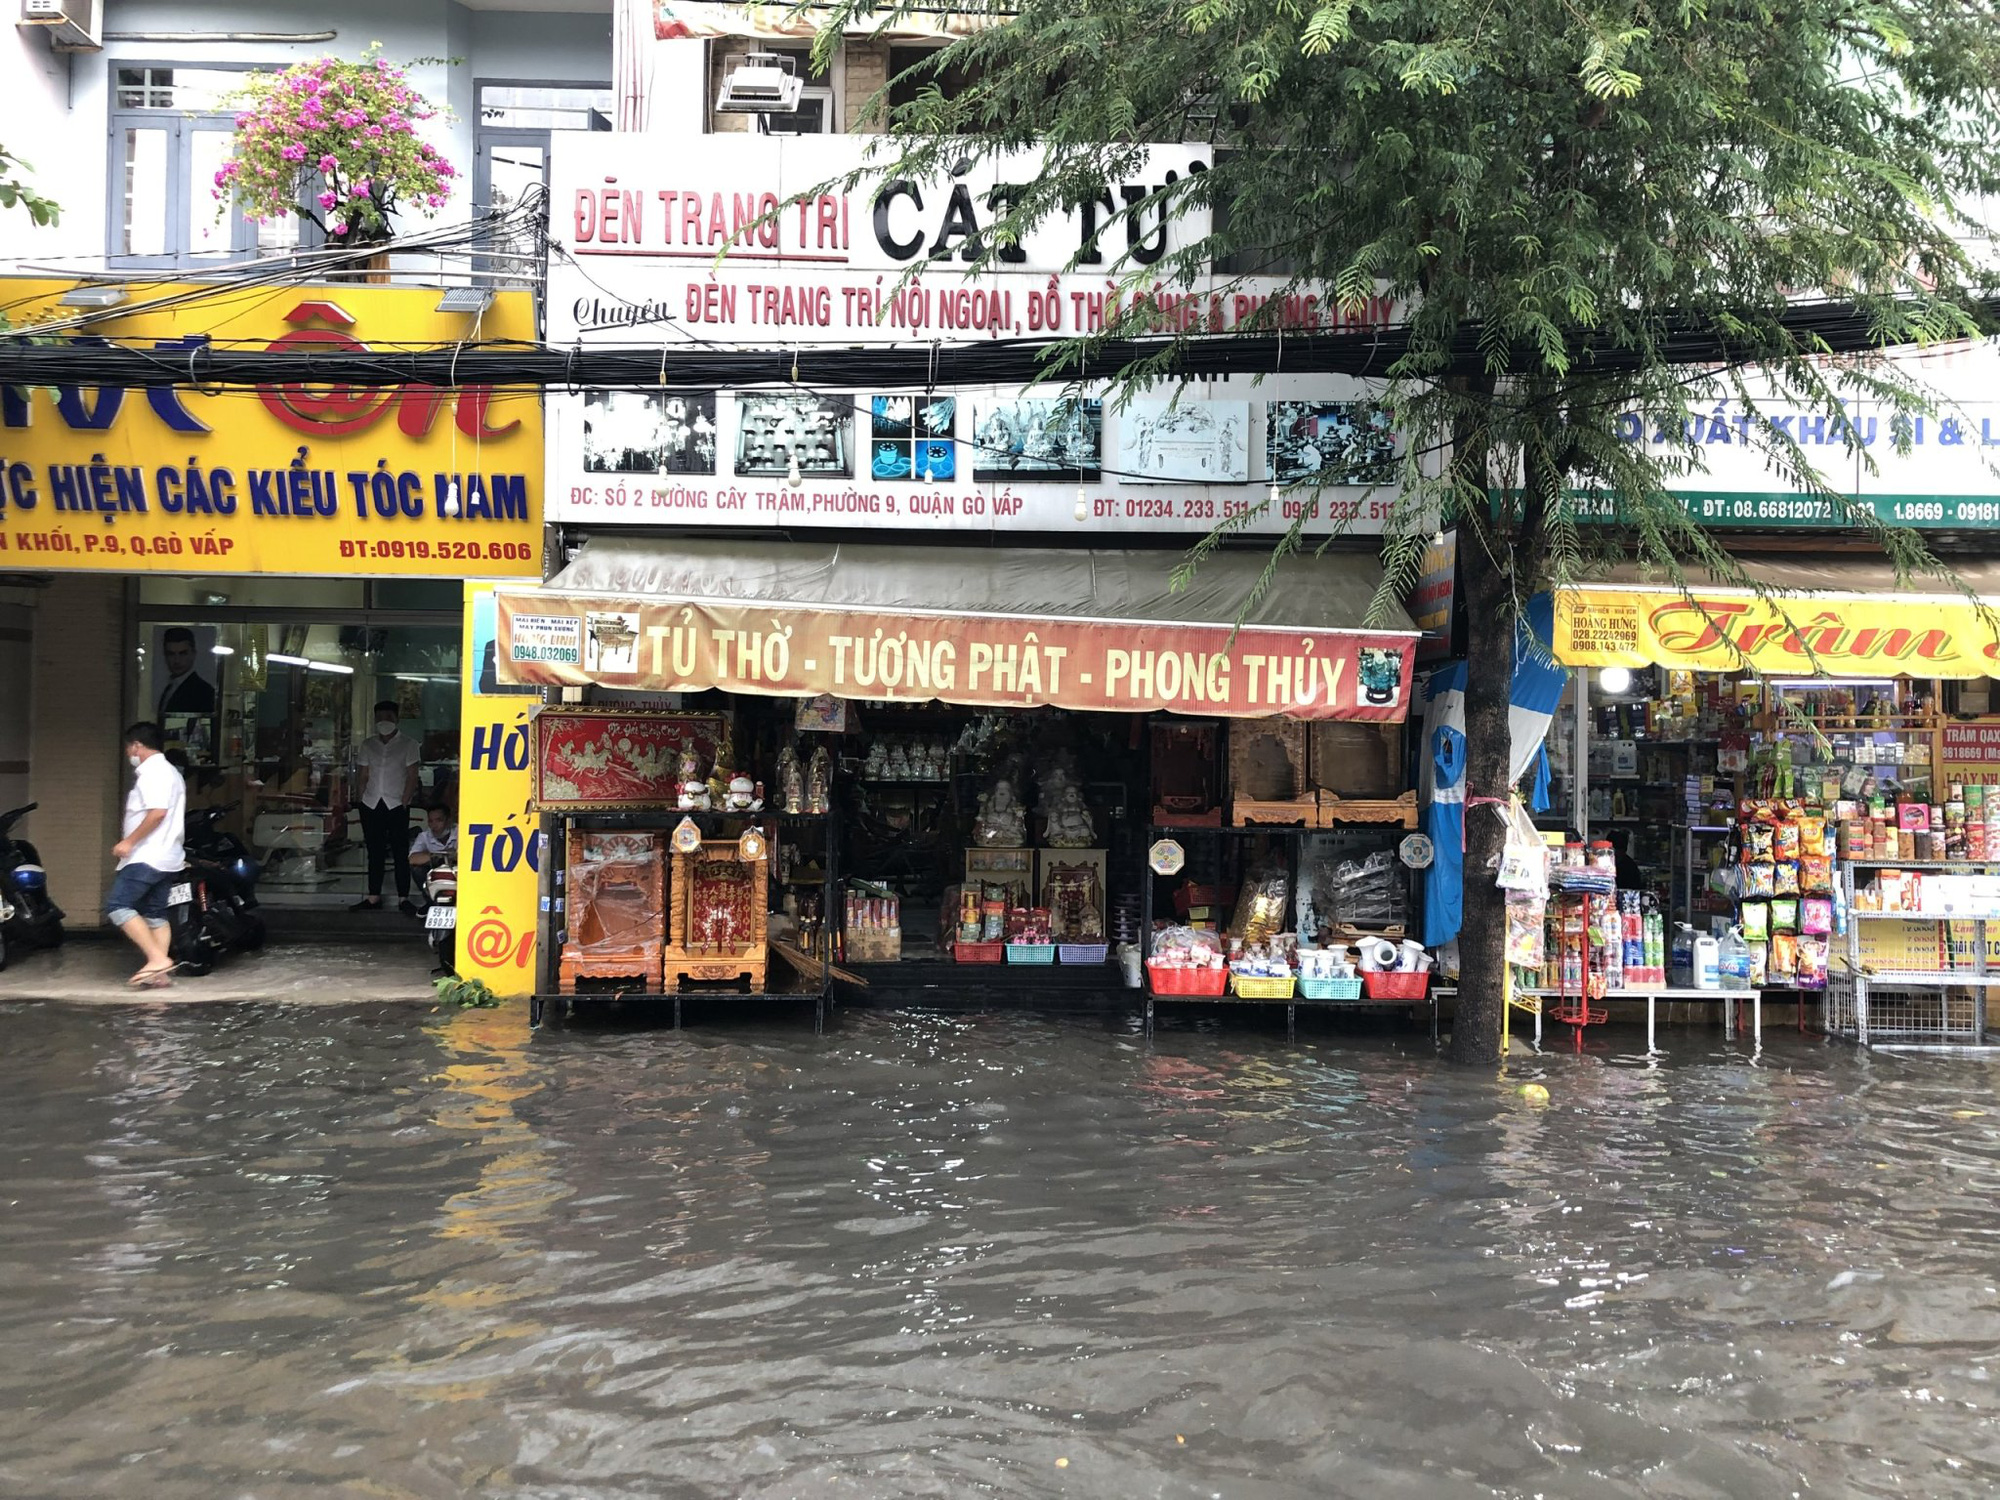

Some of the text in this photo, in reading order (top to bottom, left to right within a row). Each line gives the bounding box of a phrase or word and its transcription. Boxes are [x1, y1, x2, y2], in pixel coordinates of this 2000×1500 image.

[658, 190, 779, 249] TRANG
[573, 297, 673, 327] Chuyên
[686, 272, 736, 324] ĐÈN
[747, 285, 830, 327] TRANG
[842, 275, 882, 327] TRÍ
[890, 276, 930, 337] NỘI
[939, 288, 1021, 338] NGOẠI,
[1027, 273, 1061, 332] ĐỒ
[1234, 293, 1319, 334] PHNG
[1938, 418, 1964, 446] &
[48, 453, 150, 525] HIỆN
[156, 455, 239, 517] CÁC
[247, 446, 339, 518] KIỂU
[347, 458, 425, 519] TÓC
[434, 472, 530, 521] NAM
[571, 487, 598, 506] ĐC:
[605, 479, 627, 507] SỐ
[634, 490, 643, 506] 2
[651, 483, 708, 509] ĐƯỜNG
[716, 486, 747, 510] CÂY
[909, 492, 954, 519] QUẬN
[962, 490, 985, 516] GÒ
[993, 487, 1023, 516] VẤP
[1094, 499, 1120, 517] ĐT:
[16, 525, 81, 554] KHỐI,
[84, 534, 127, 555] P.9,
[189, 529, 235, 556] VẤP
[1573, 614, 1607, 629] HOÀNG
[1573, 629, 1637, 641] 028.22242969
[1648, 600, 1962, 661] Trâm
[514, 645, 578, 662] 0948.032069
[647, 608, 697, 677] TỦ
[712, 618, 793, 682] THỜ
[829, 627, 956, 698] TƯỢNG
[968, 632, 1067, 704] PHẬT
[1106, 649, 1231, 703] PHONG
[1243, 638, 1346, 706] THỦY
[1573, 640, 1636, 651] 0908.143.472
[1946, 726, 1977, 742] TRÂM
